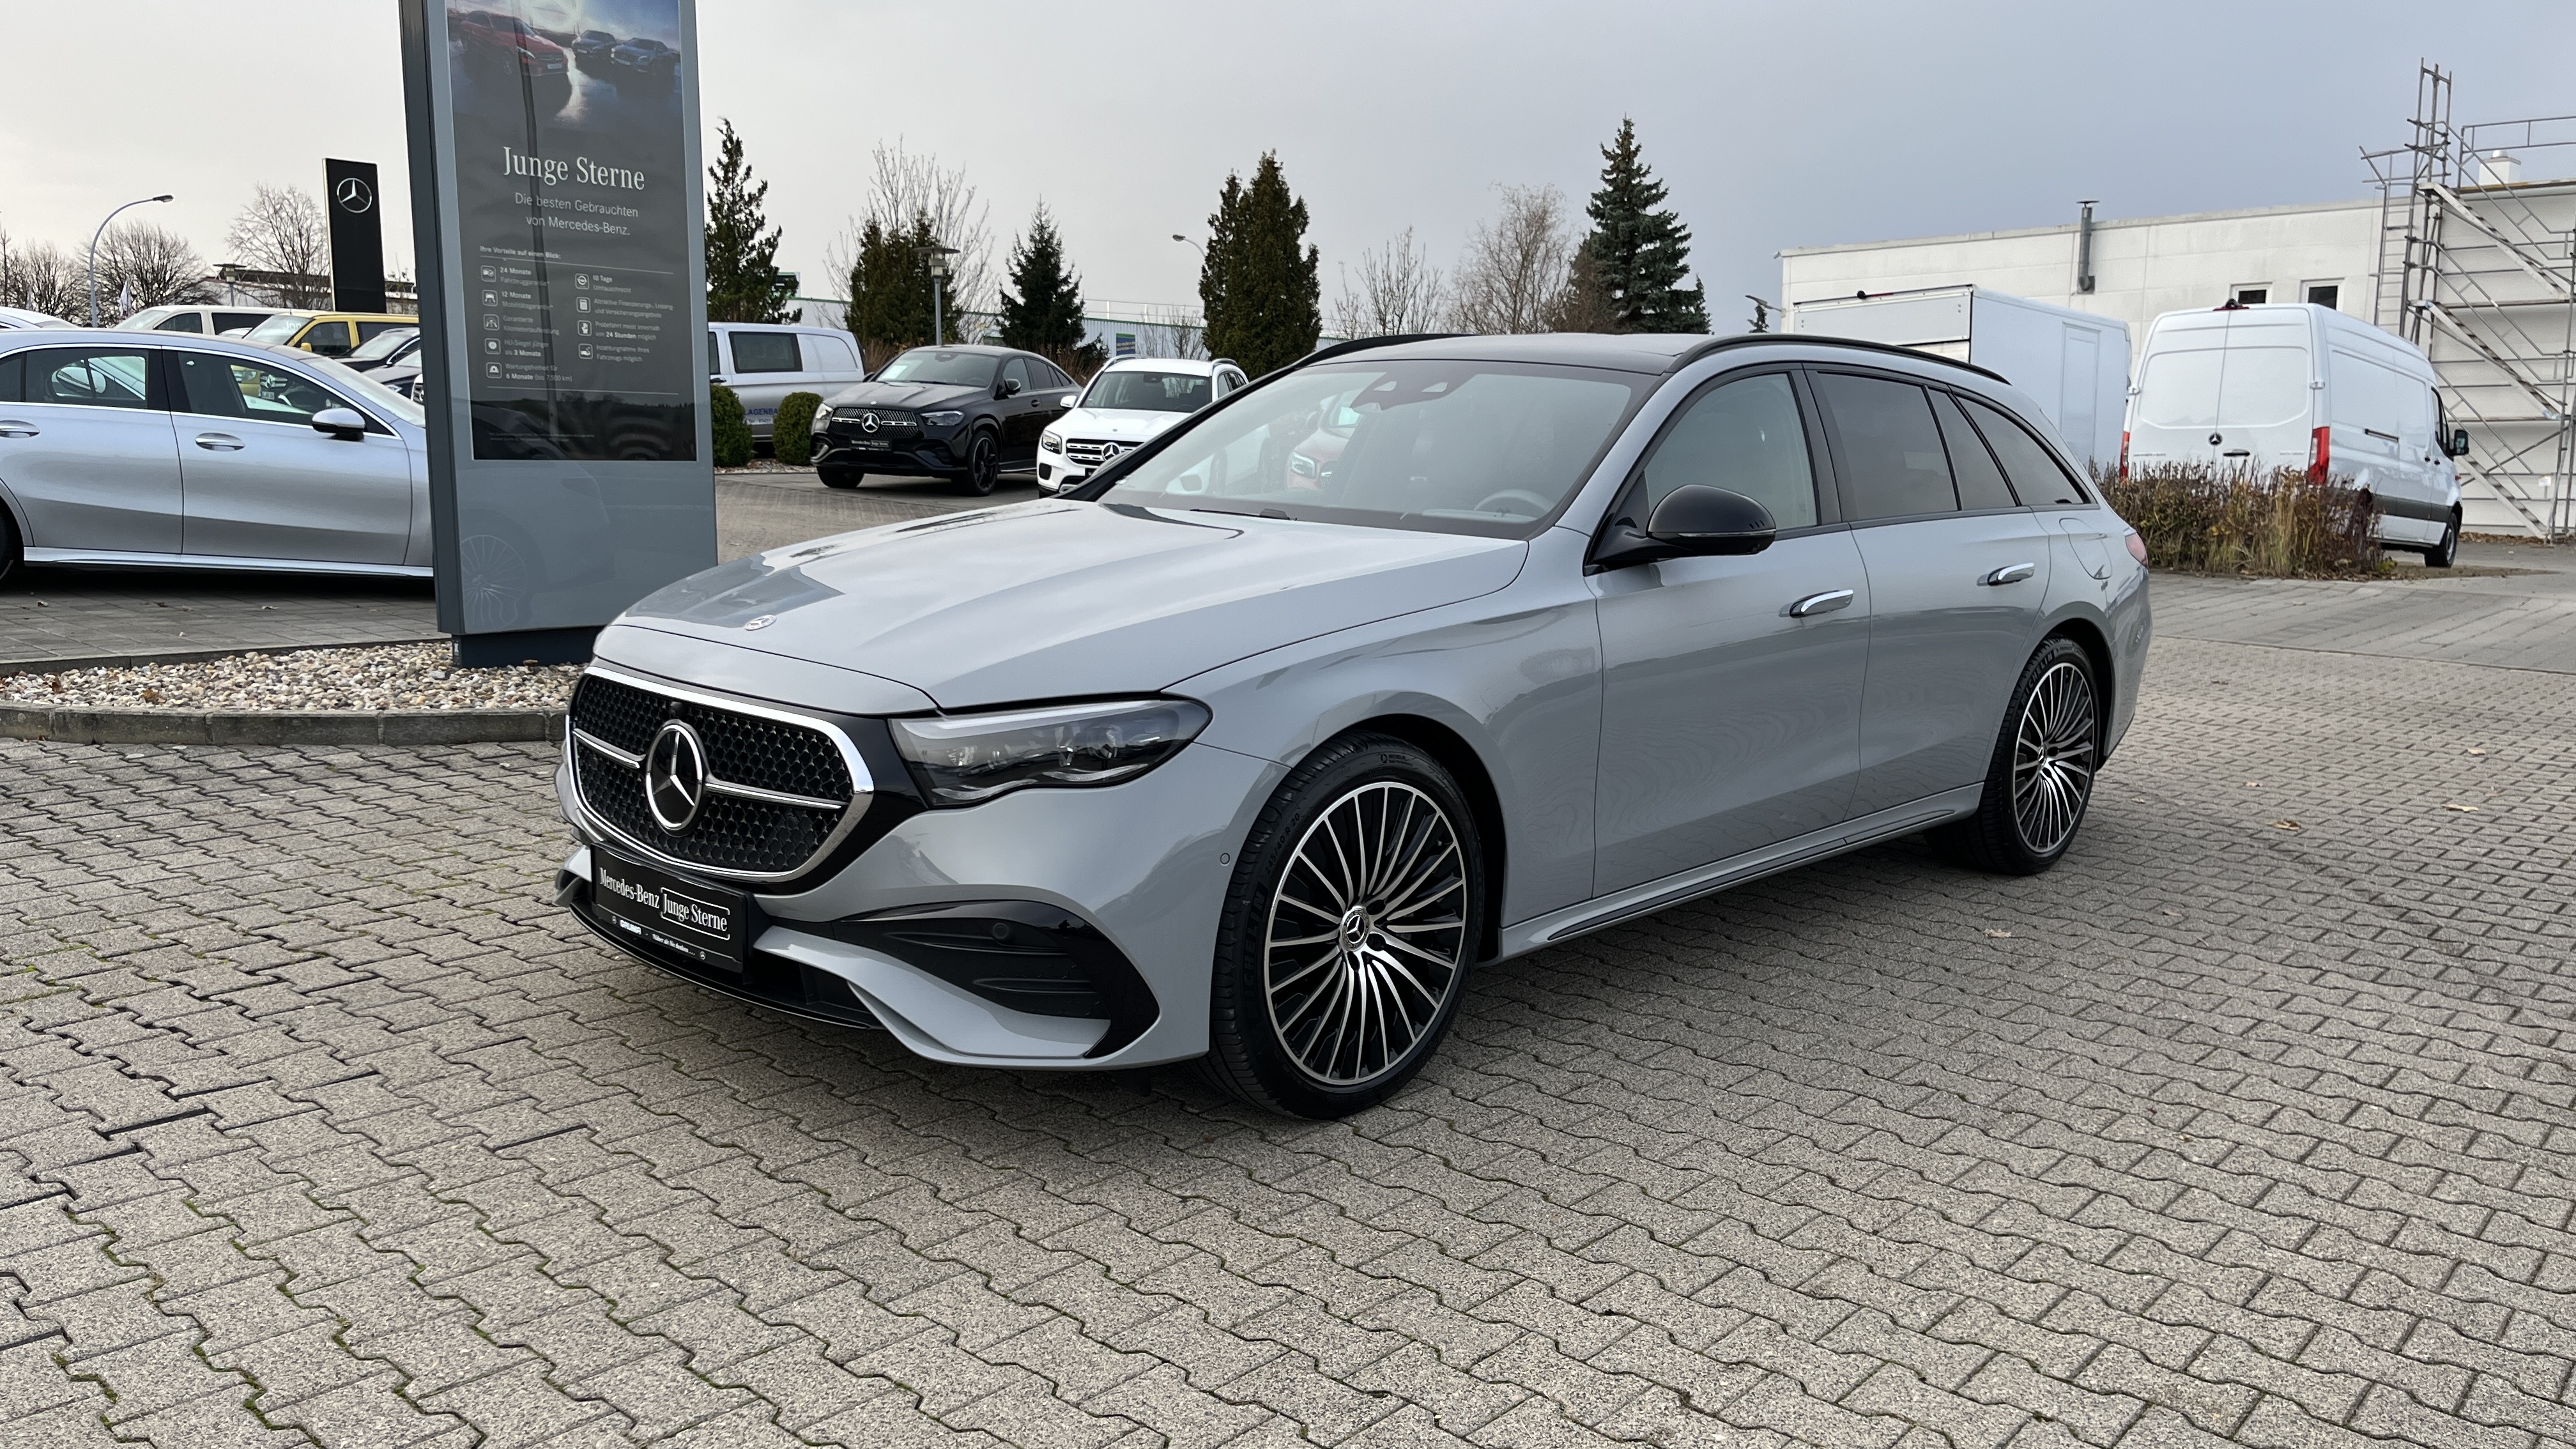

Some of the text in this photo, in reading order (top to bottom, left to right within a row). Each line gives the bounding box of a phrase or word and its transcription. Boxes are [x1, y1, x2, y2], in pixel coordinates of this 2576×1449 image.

[503, 146, 645, 190] Junge Sterne
[515, 192, 639, 217] Die besten Gebrauchten
[526, 216, 631, 236] von Mercedes-Benz.
[509, 268, 532, 276] Monate
[600, 275, 613, 284] Tage
[2020, 652, 2053, 707] MICHELIN
[1265, 813, 1300, 875] 245/40 R 20
[599, 867, 728, 932] Mercedes-Benz Junge Sterne
